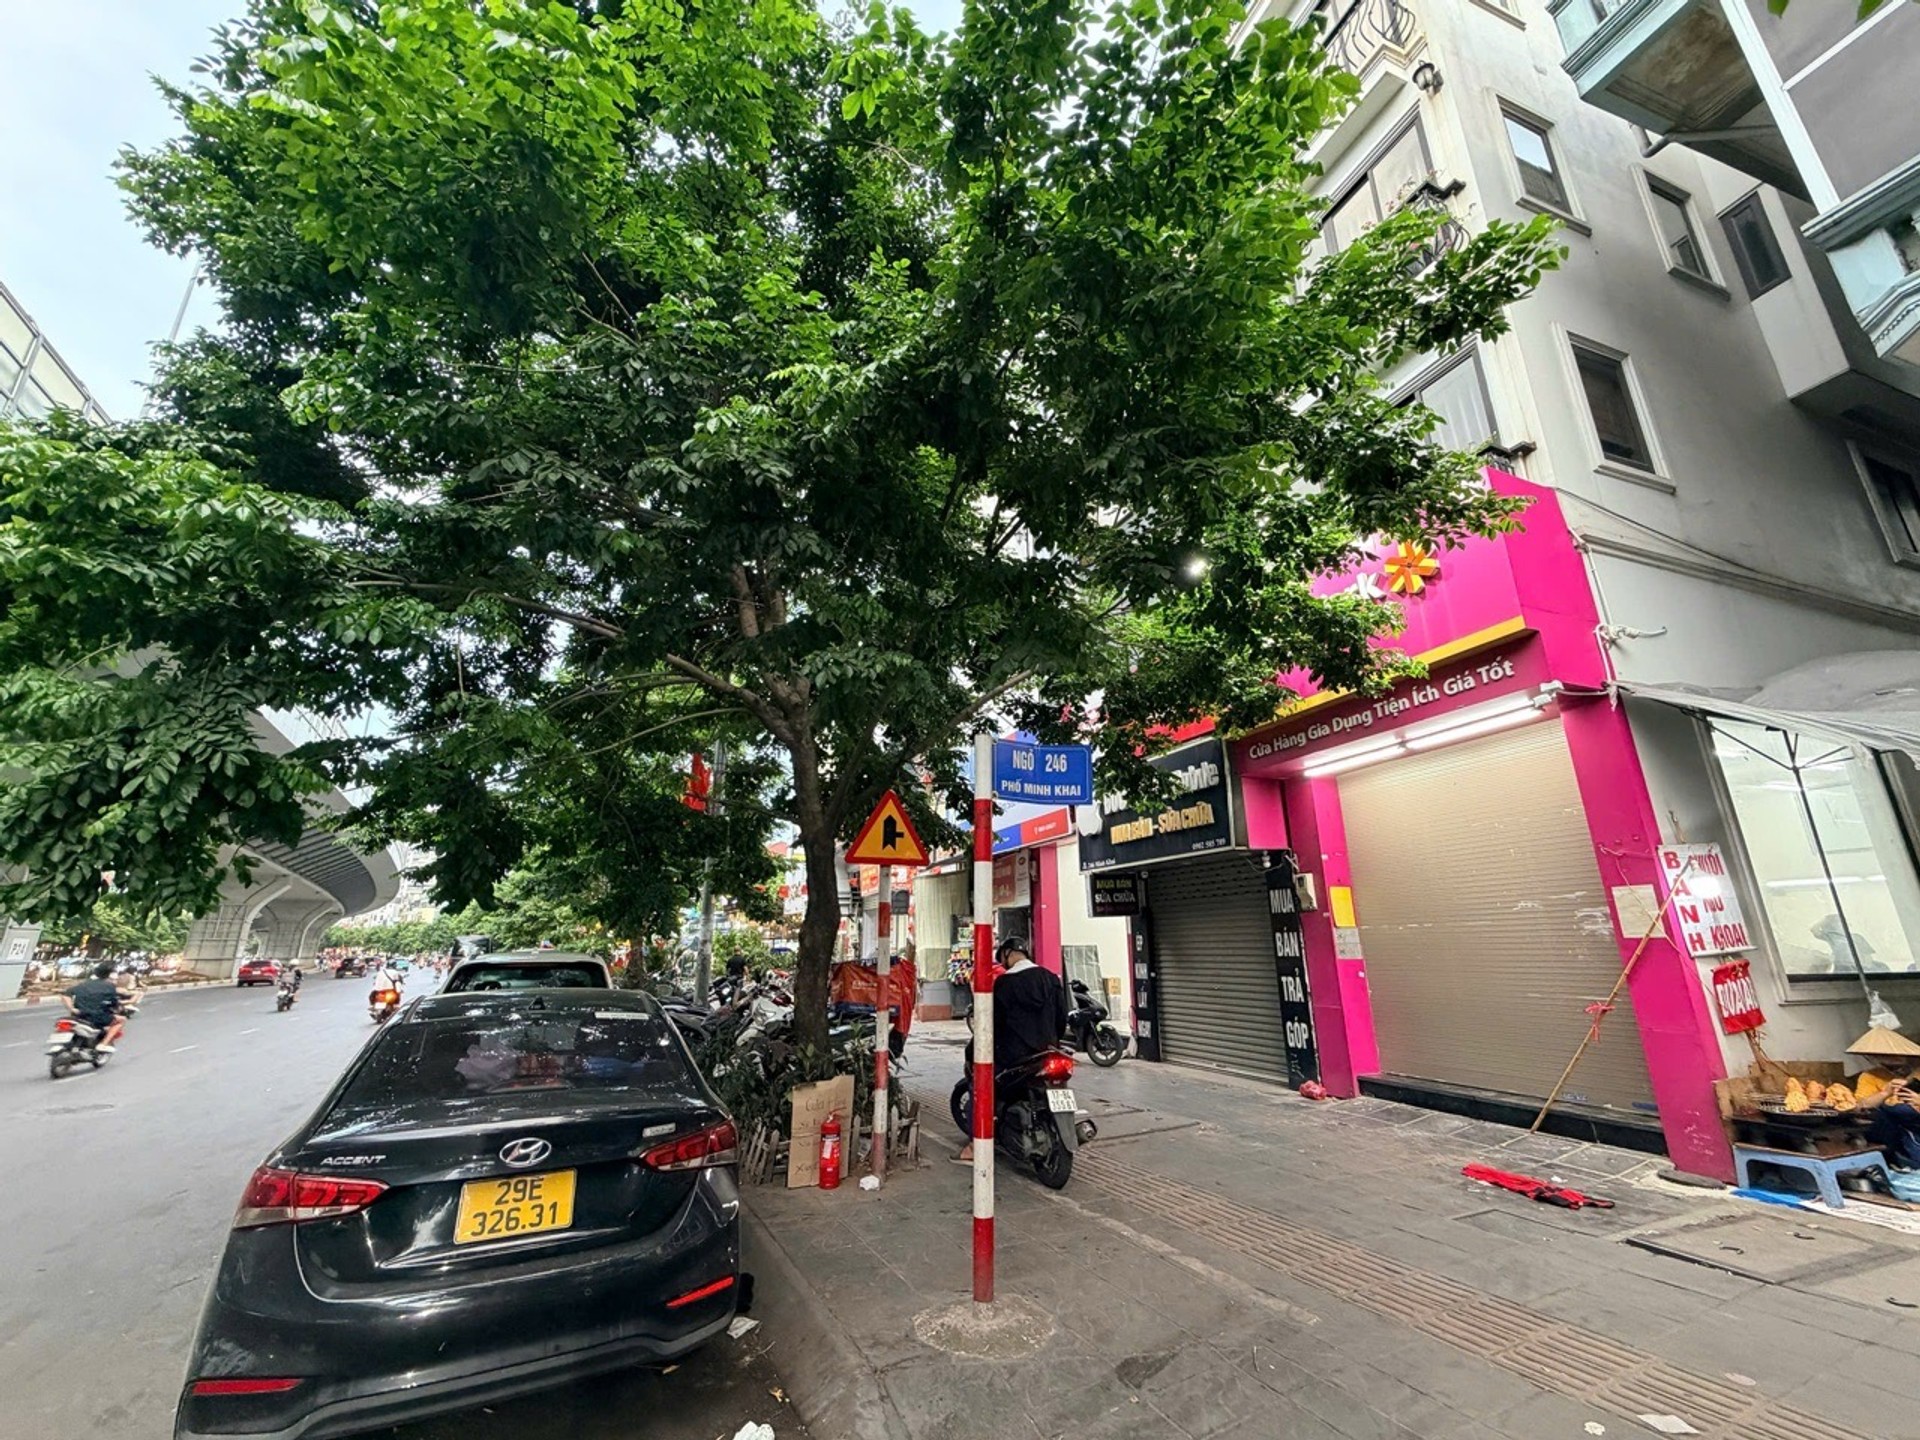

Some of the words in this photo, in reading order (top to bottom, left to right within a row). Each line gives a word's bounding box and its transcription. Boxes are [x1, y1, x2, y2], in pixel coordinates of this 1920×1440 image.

[1249, 742, 1272, 759] Cửa
[1273, 732, 1307, 752] Hàng
[1307, 723, 1330, 740] Gia
[1331, 710, 1373, 732] Dụng
[1373, 697, 1411, 718] Tiện
[1411, 684, 1440, 706] Ích
[1443, 670, 1476, 696] Giá
[1476, 656, 1515, 684] Tốt
[1045, 753, 1068, 773] 246
[1001, 778, 1022, 793] PHỐ
[1023, 782, 1052, 796] MINH
[1054, 784, 1081, 796] KHAI
[1269, 888, 1295, 914] MUA
[1275, 927, 1300, 957] BÁN
[1281, 968, 1305, 1002] TRẢ
[1286, 1016, 1309, 1050] GÓP
[320, 1154, 387, 1167] ACCENT
[494, 1177, 545, 1207] 29E
[470, 1201, 559, 1238] 326.31
